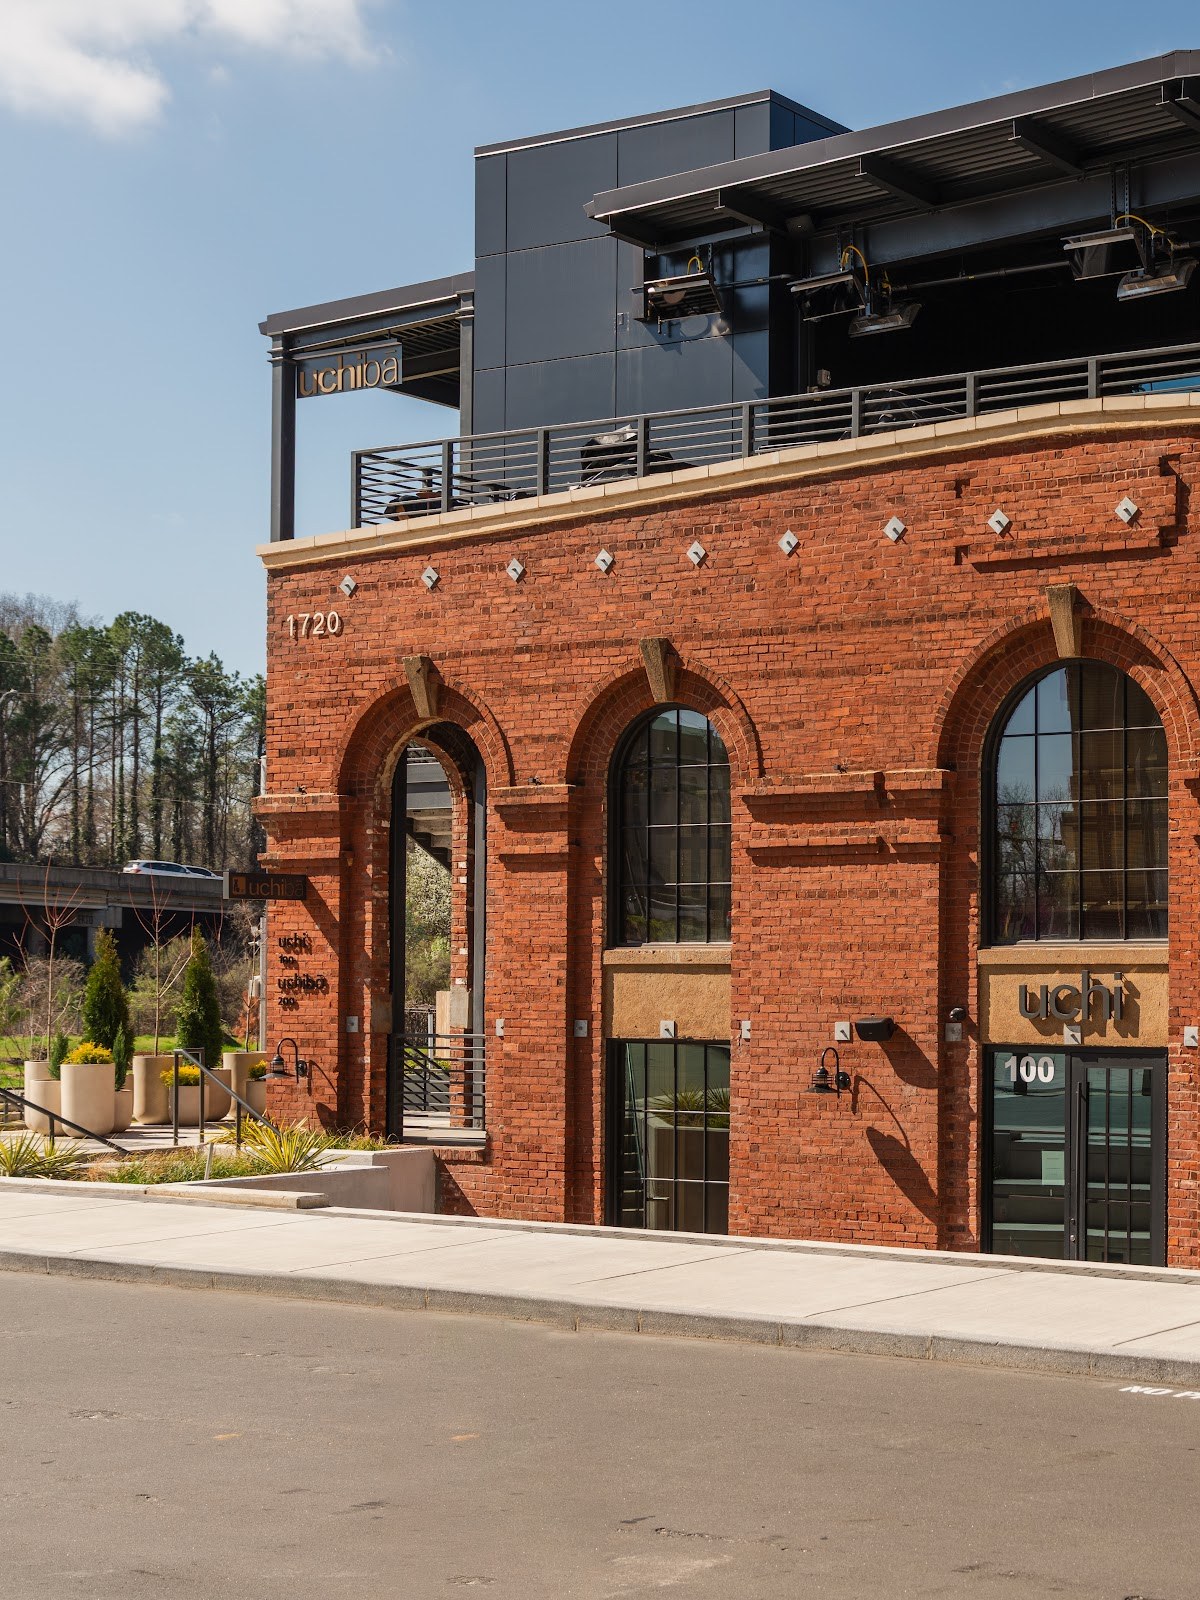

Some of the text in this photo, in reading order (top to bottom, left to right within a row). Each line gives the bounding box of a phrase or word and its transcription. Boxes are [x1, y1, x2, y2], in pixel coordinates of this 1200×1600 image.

[286, 611, 339, 637] 1720
[279, 932, 306, 947] uchi
[279, 954, 294, 963] 100
[278, 997, 295, 1005] 200
[1018, 970, 1123, 1021] uchi
[1004, 1055, 1055, 1083] 100
[1119, 1385, 1174, 1395] NO
